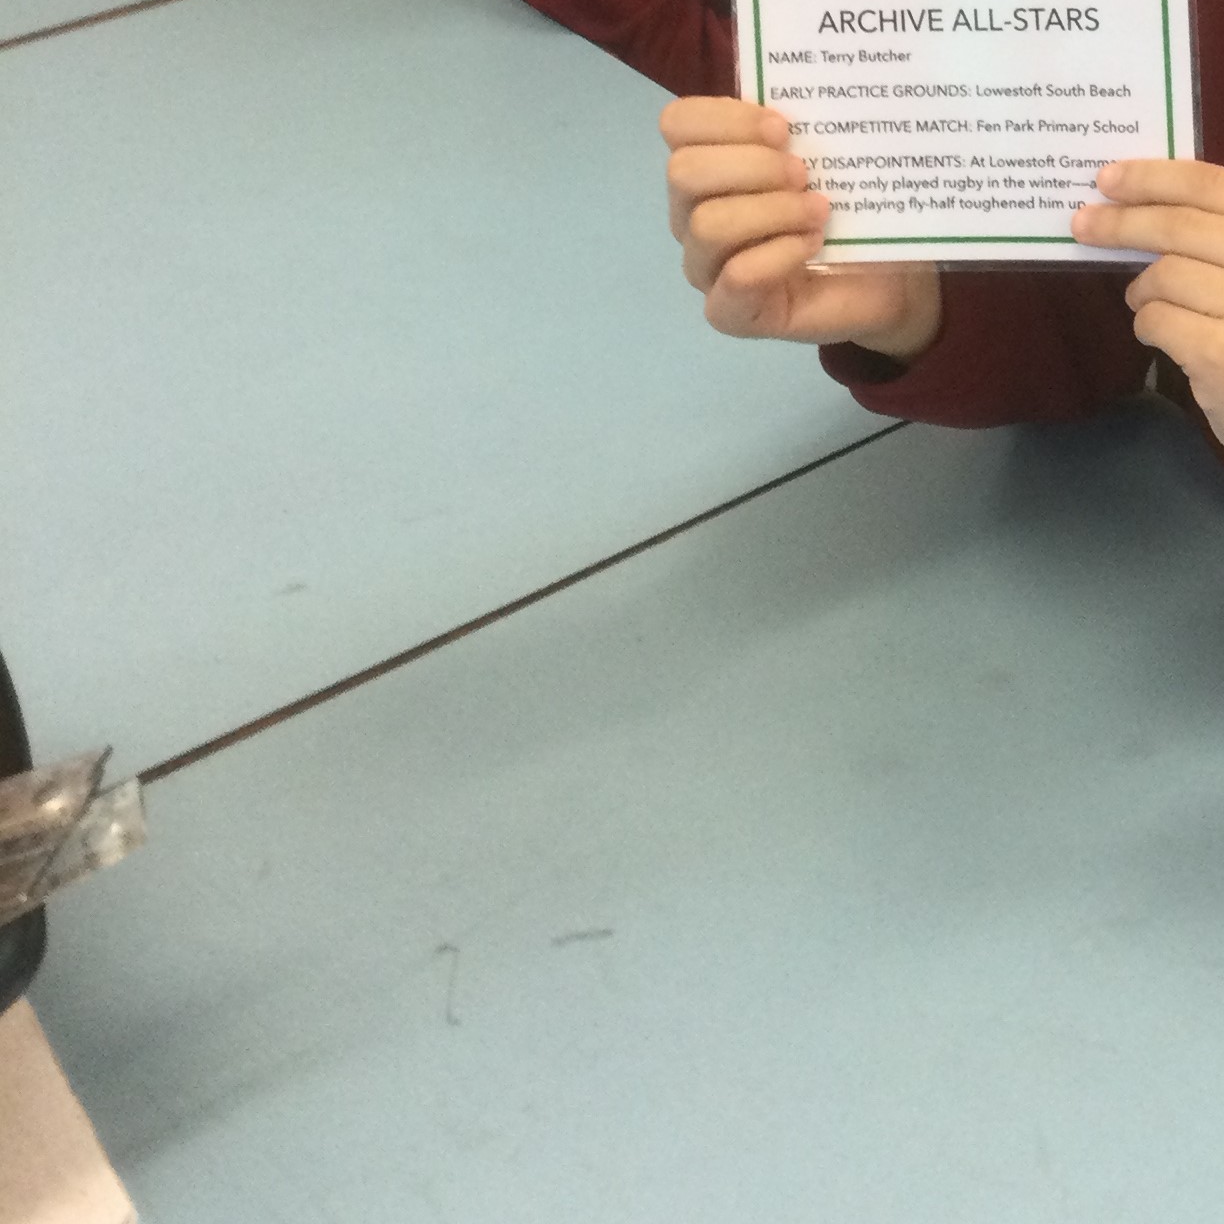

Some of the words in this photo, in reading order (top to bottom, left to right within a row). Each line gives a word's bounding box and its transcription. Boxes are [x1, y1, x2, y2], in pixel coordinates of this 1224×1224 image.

[818, 8, 944, 34] ARCHIVE
[952, 7, 1101, 32] ALL-STARS
[768, 51, 817, 64] NAME:
[821, 50, 855, 66] Terry
[858, 49, 912, 63] Butcher
[770, 86, 814, 100] EARLY
[818, 85, 889, 99] PRACTICE
[892, 84, 971, 98] GROUNDS:
[975, 83, 1042, 97] Lowestoft
[1045, 83, 1085, 97] South
[1089, 84, 1131, 97] Beach
[814, 120, 912, 135] COMPETITIVE
[976, 119, 1001, 132] Fen
[1005, 119, 1034, 132] Park
[1038, 119, 1090, 136] Primary
[1093, 120, 1139, 134] School
[822, 155, 966, 170] DISAPPOINTMENTS:
[970, 155, 985, 168] At
[989, 155, 1055, 168] Lowestoft
[1059, 155, 1117, 168] Gramm
[825, 177, 855, 193] they
[859, 177, 888, 193] only
[892, 176, 938, 192] played
[943, 176, 983, 192] rugby
[987, 176, 999, 188] in
[1003, 176, 1026, 188] the
[854, 198, 905, 213] playing
[908, 196, 955, 211] fly-half
[959, 196, 1035, 212] toughened
[1039, 196, 1064, 209] him
